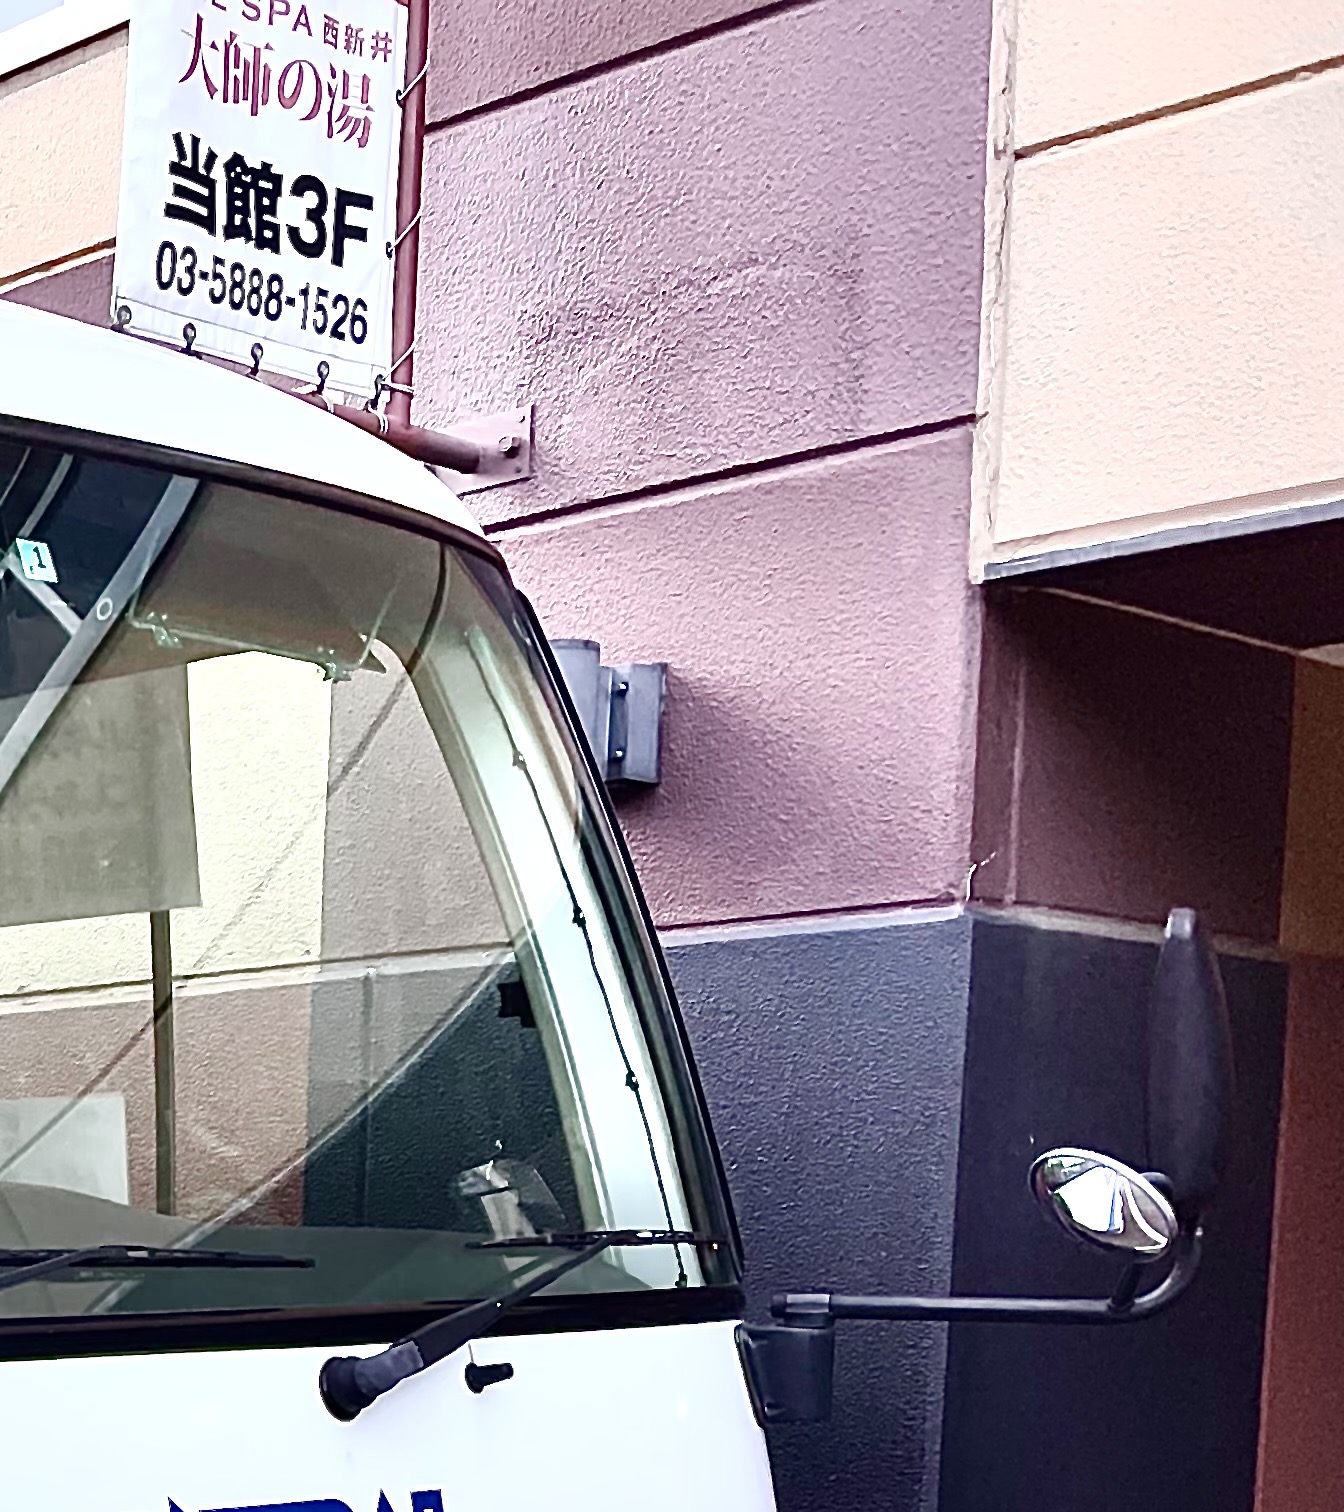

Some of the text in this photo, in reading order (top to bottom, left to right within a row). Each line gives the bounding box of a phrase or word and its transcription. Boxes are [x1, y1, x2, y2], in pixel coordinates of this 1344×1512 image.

[179, 13, 376, 149] 大師の湯
[323, 13, 393, 63] 西新井
[164, 132, 374, 267] 当館3F
[155, 241, 369, 345] 03-5888-1526
